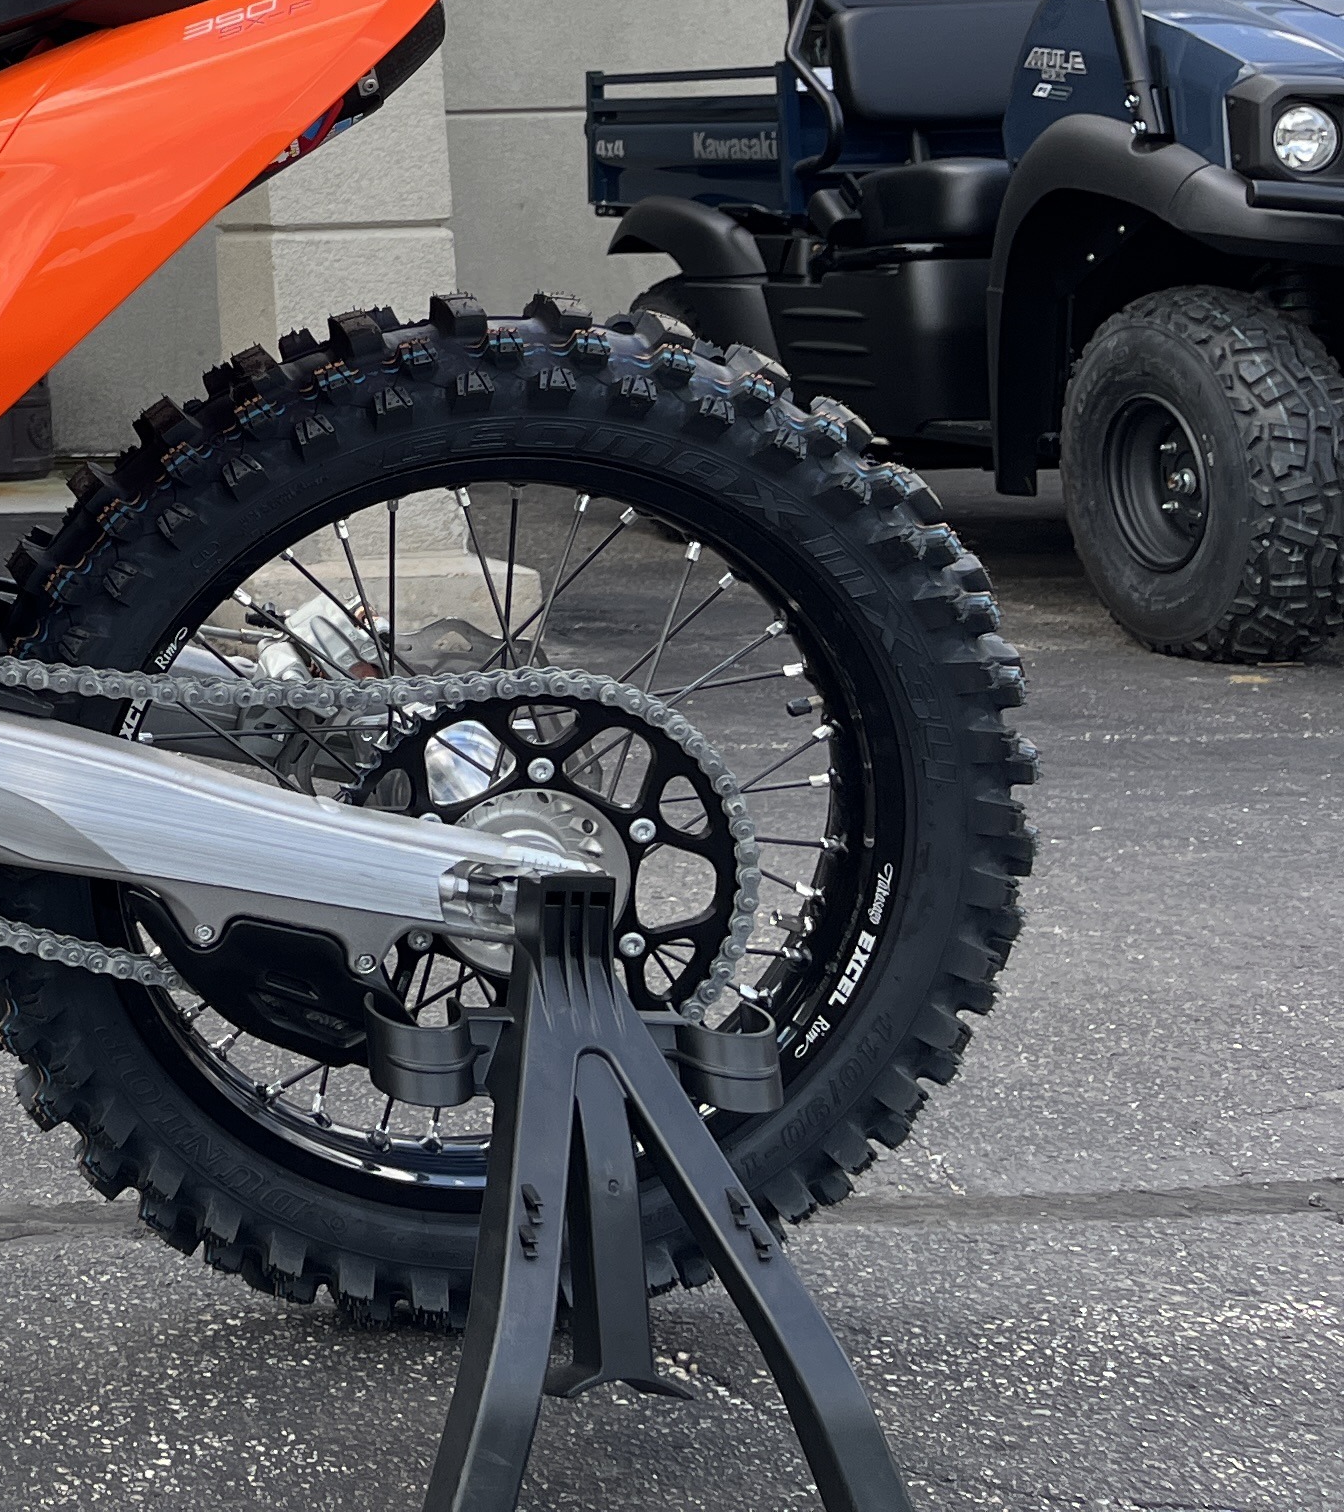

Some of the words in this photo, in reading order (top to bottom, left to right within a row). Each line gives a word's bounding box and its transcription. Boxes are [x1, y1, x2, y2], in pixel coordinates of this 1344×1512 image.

[1023, 47, 1088, 75] MULE
[595, 139, 625, 159] 4x4
[692, 131, 779, 161] Kawasaki
[828, 930, 877, 1006] EXCEL
[739, 1010, 896, 1179] 110/90-1
